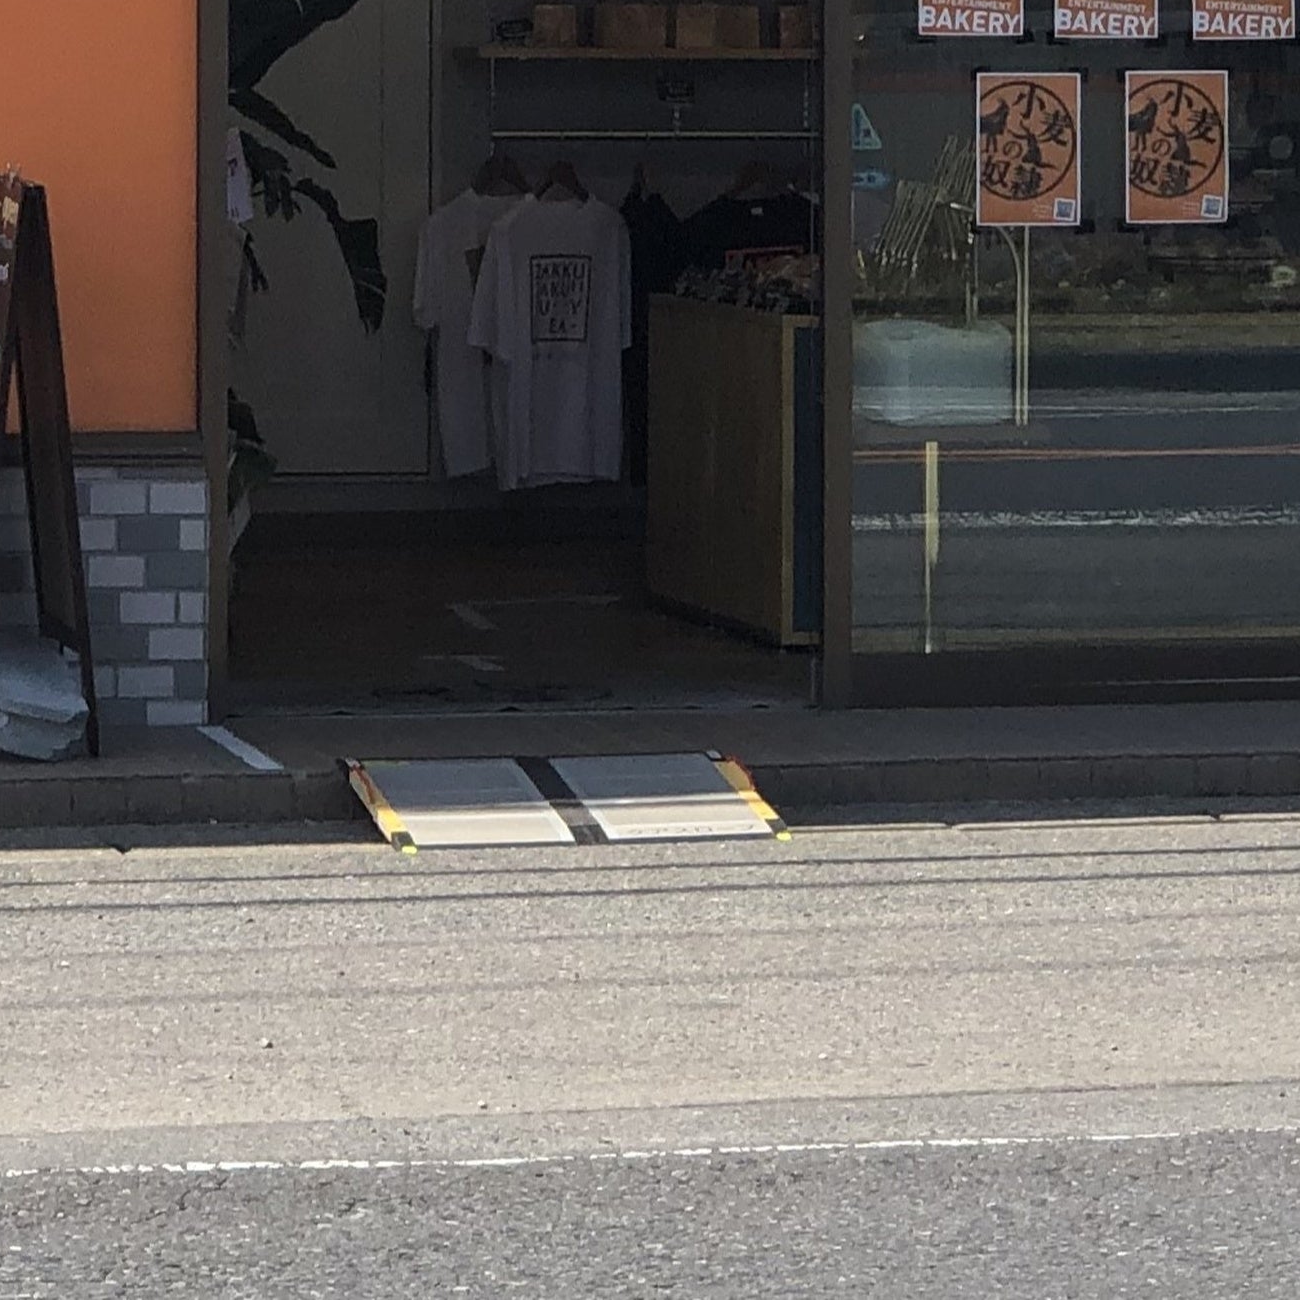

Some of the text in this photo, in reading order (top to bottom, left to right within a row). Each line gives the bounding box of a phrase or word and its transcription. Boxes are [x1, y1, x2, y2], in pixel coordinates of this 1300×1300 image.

[919, 5, 1020, 35] BAKERY
[1055, 8, 1154, 38] BAKERY
[1193, 11, 1292, 38] BAKERY
